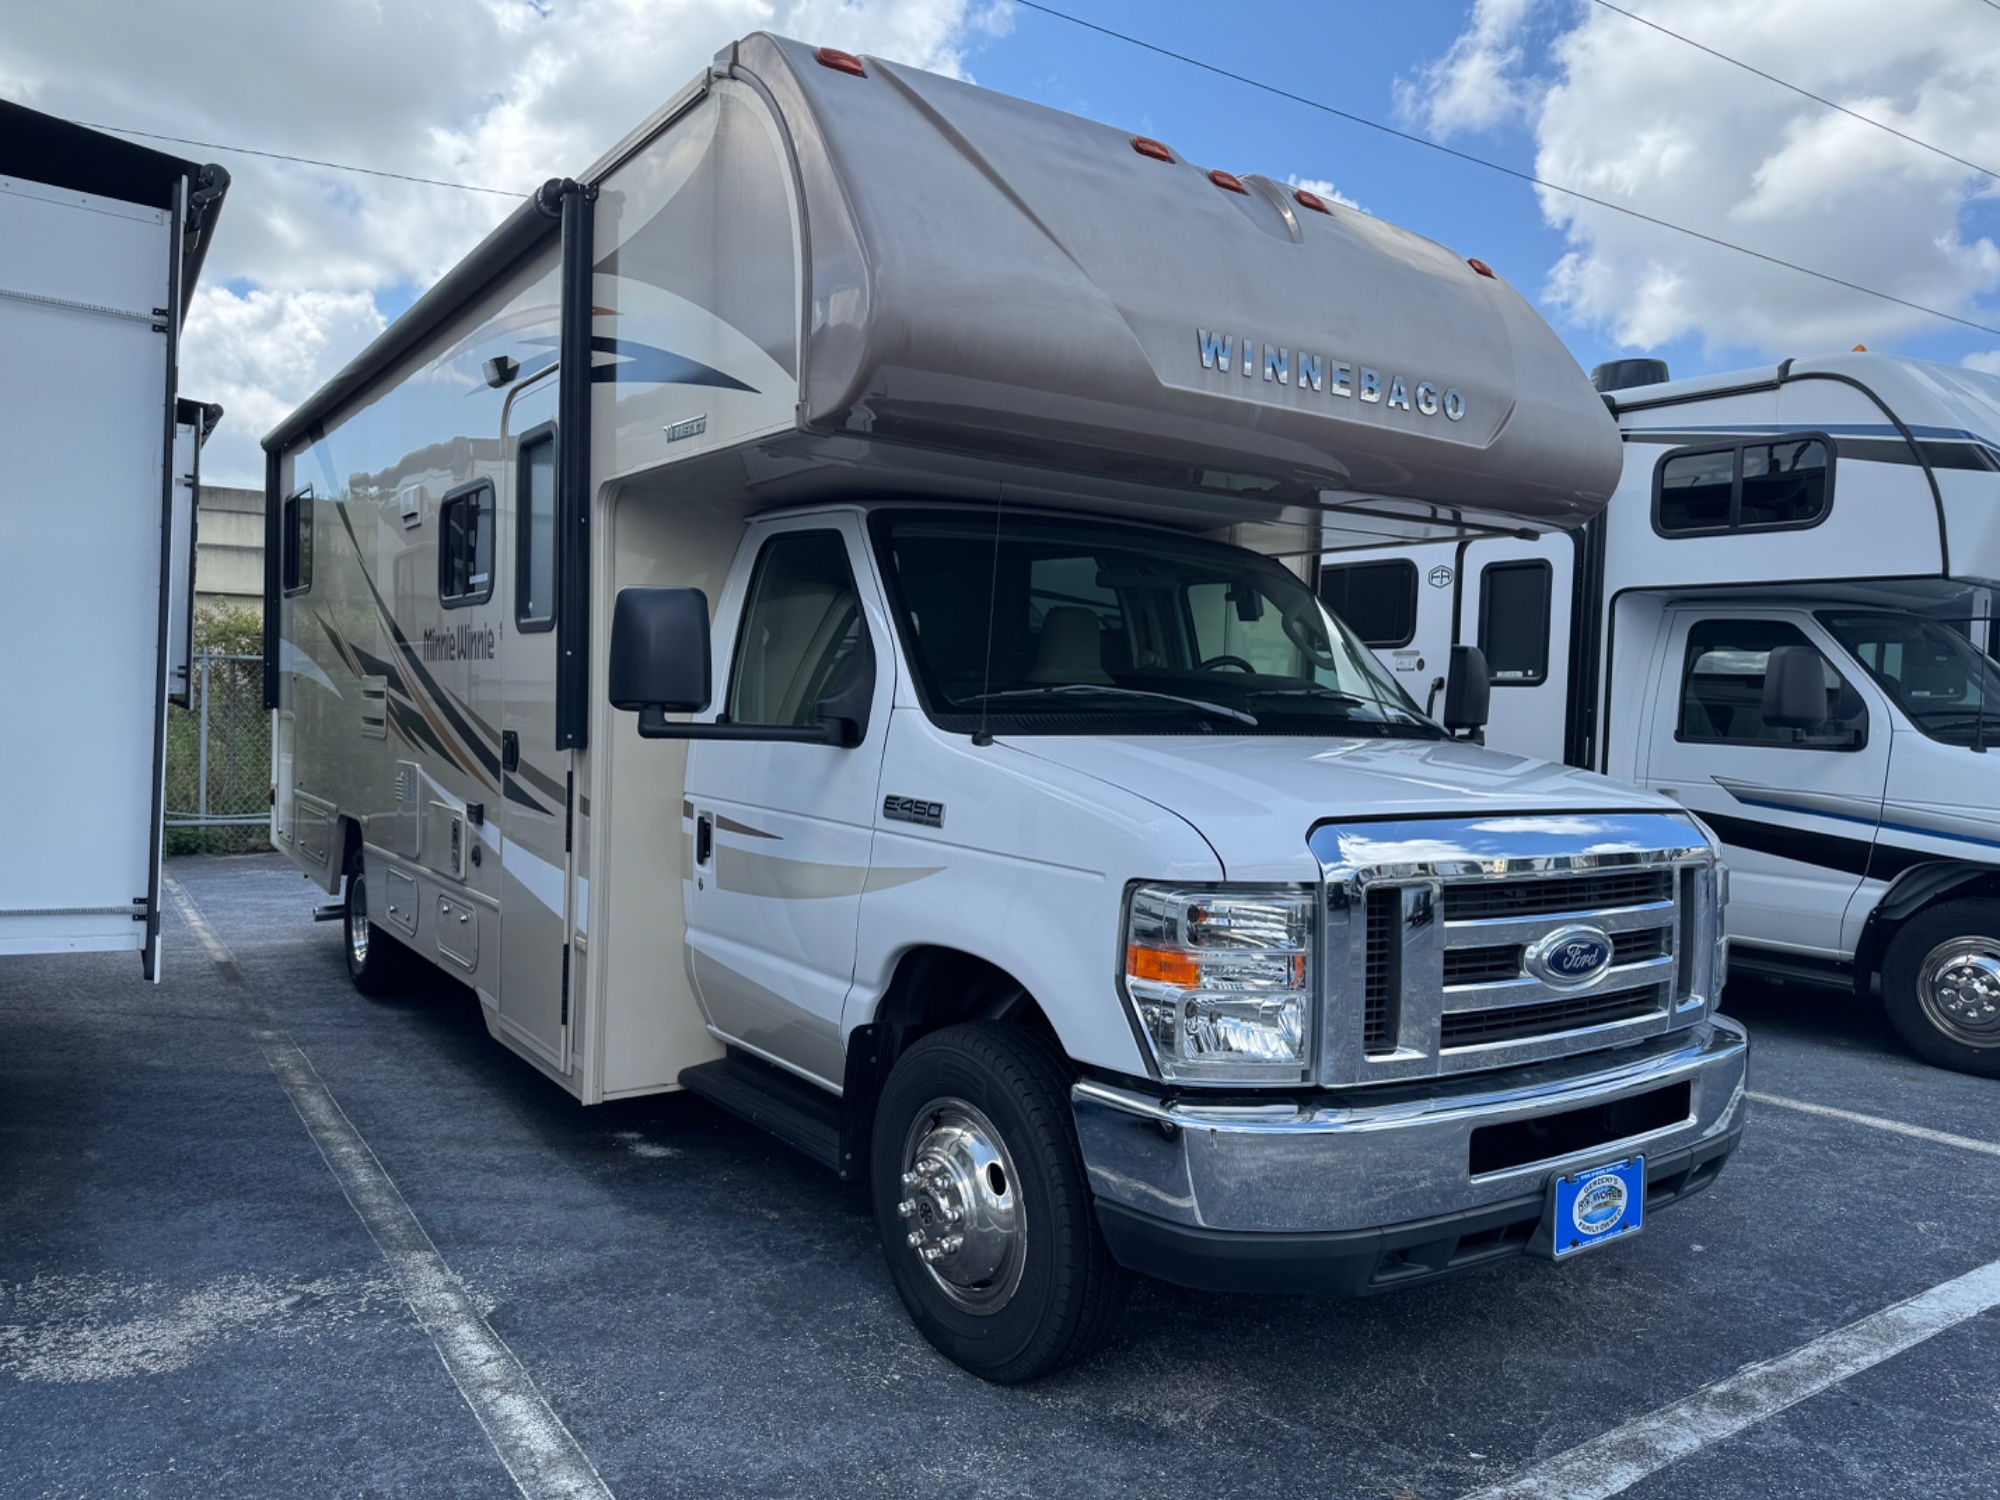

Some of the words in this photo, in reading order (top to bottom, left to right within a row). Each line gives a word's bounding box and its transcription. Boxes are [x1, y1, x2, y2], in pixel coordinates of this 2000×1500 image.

[1197, 328, 1466, 421] WINNEBAGO
[424, 626, 456, 661] Minnie
[458, 622, 494, 660] Winnie
[884, 796, 943, 818] E-450
[1563, 944, 1599, 969] Ford
[1594, 1187, 1622, 1202] WORLD
